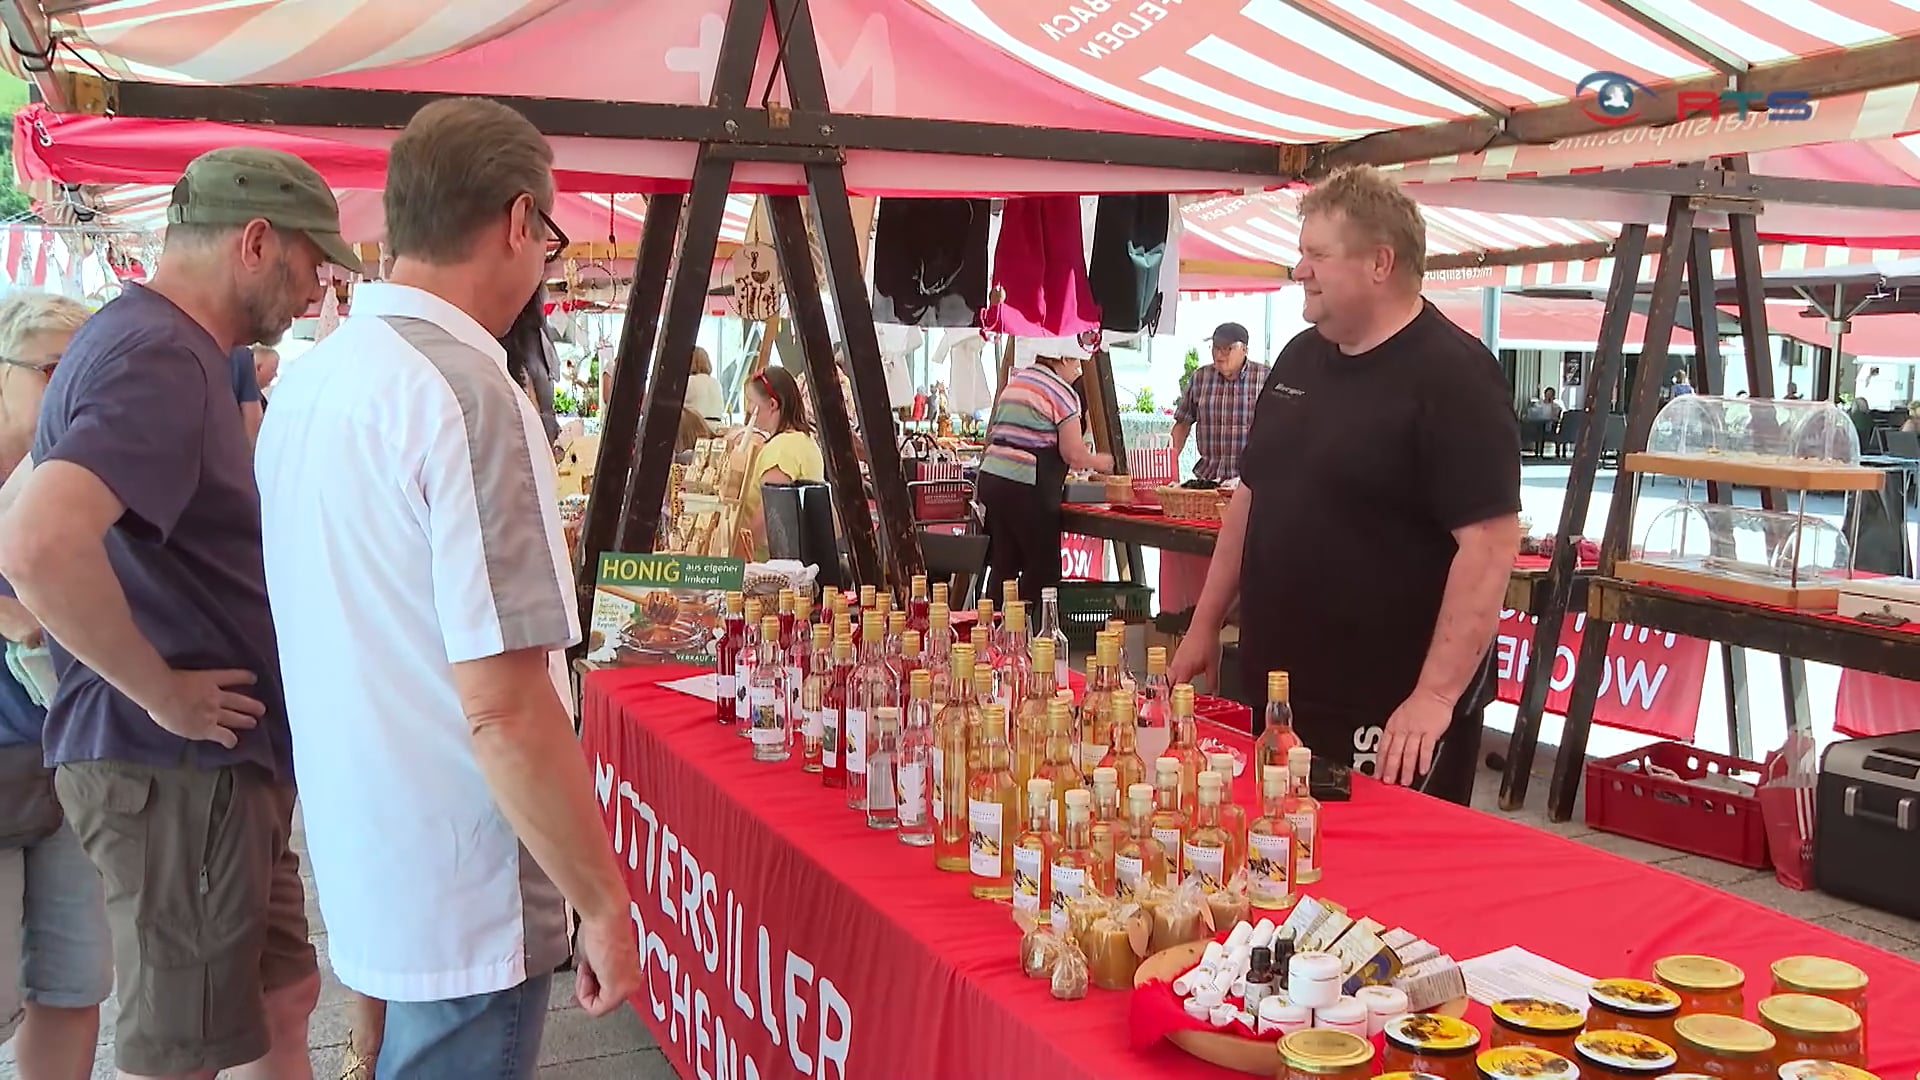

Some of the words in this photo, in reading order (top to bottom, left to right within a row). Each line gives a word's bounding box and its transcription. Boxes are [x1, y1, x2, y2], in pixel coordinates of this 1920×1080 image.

[602, 558, 681, 582] HONIG
[685, 563, 702, 571] aus
[704, 562, 738, 574] eigener
[684, 575, 720, 584] Imkerei
[676, 652, 709, 663] VERKAUF
